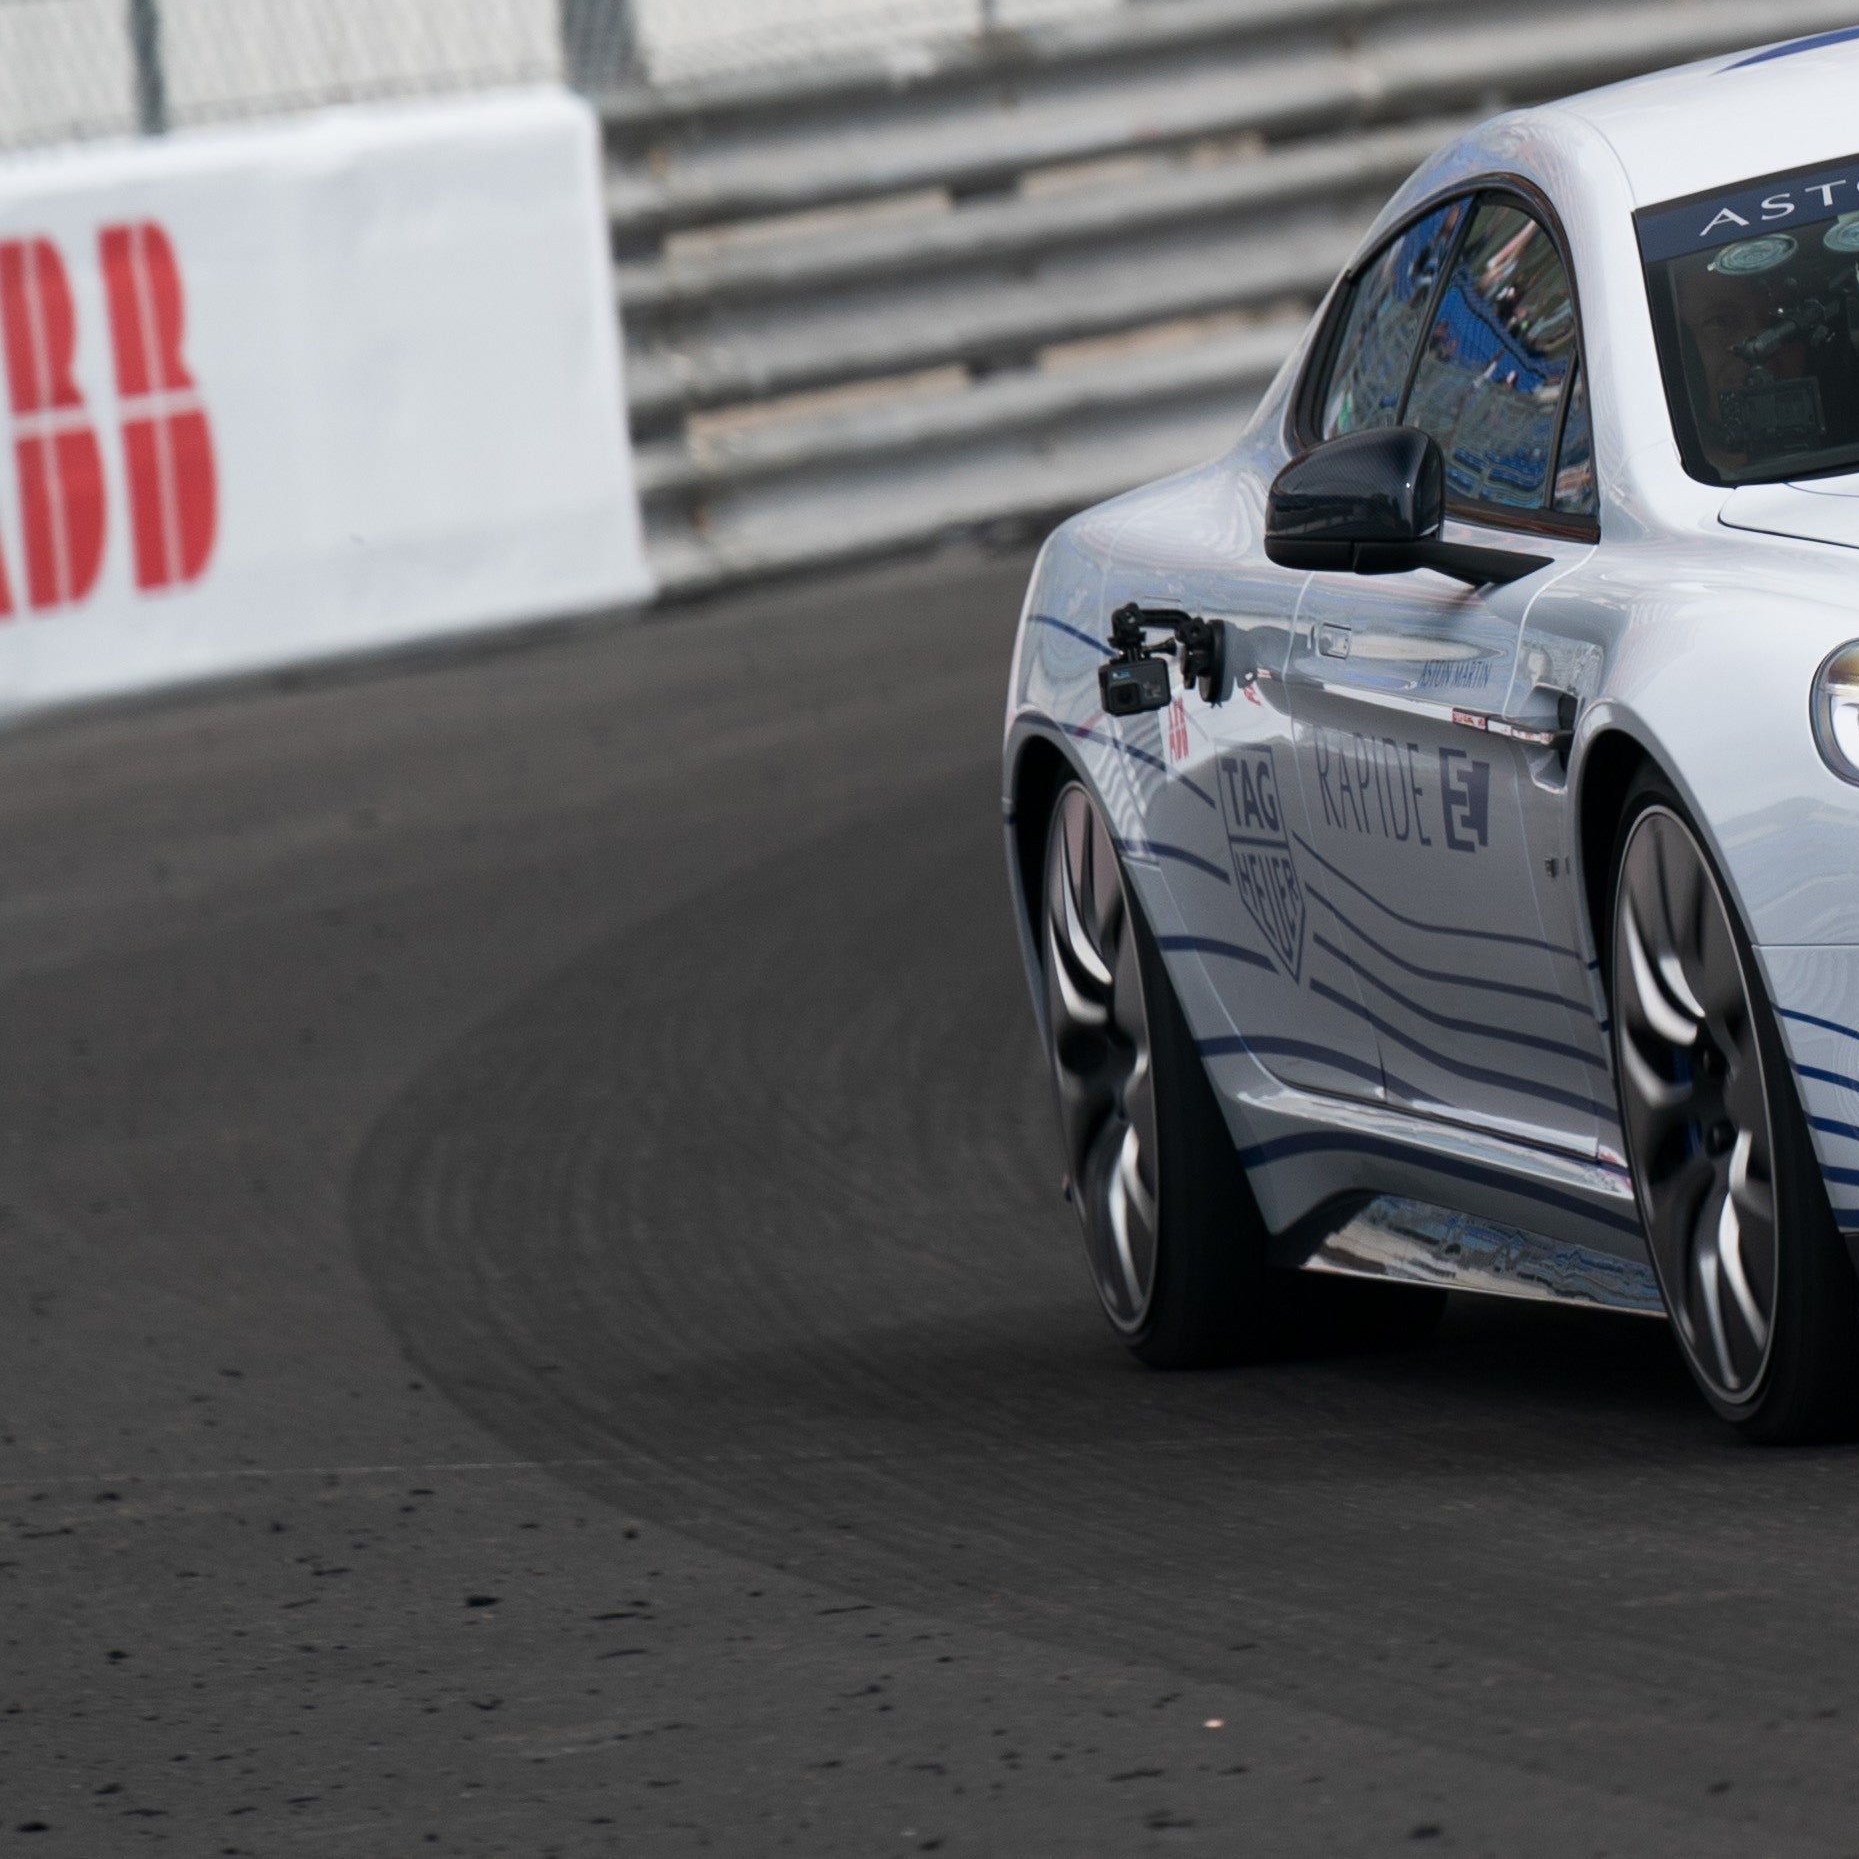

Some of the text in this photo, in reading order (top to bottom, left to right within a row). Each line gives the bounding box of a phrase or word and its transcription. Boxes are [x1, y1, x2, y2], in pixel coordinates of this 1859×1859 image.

[0, 219, 218, 619] BB
[1221, 758, 1280, 832] TAG
[1313, 726, 1432, 847] RAPIDE
[1234, 852, 1299, 964] HEUER
